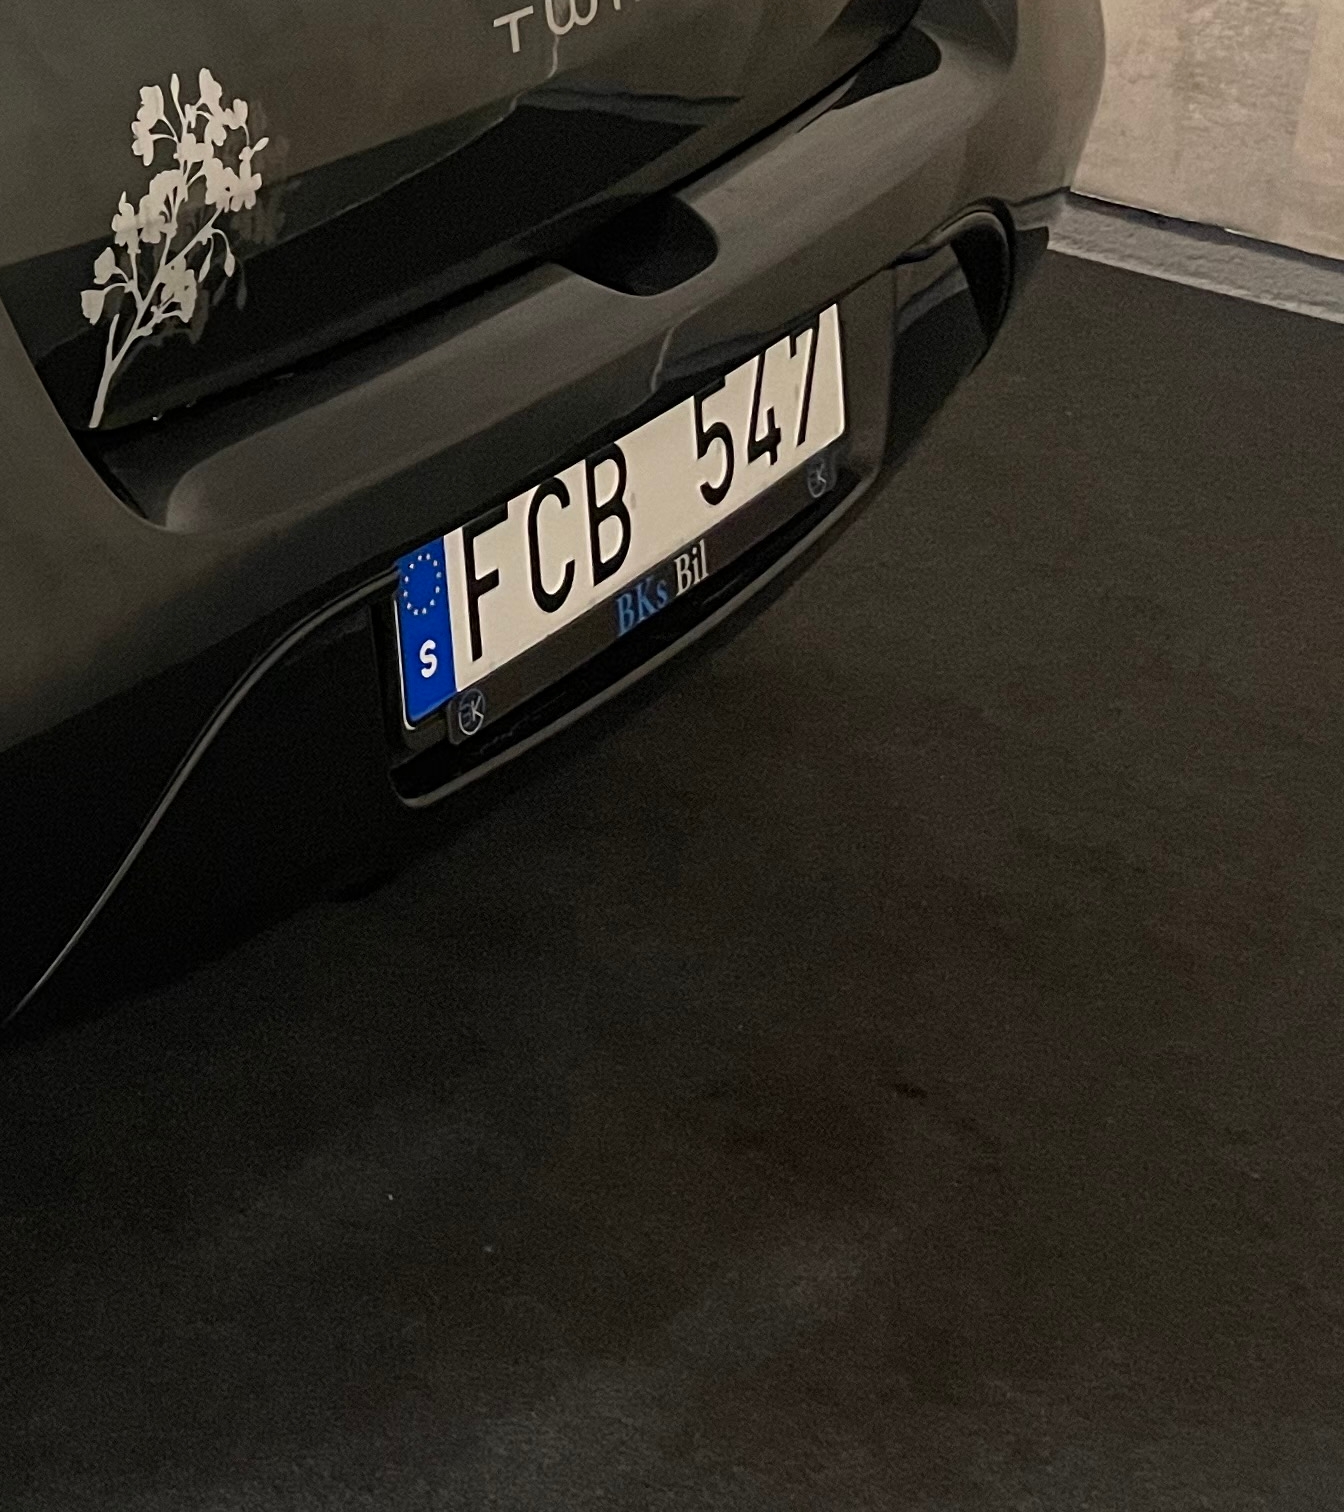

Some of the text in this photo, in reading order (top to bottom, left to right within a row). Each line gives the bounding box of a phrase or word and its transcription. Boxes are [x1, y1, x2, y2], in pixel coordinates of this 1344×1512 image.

[461, 314, 822, 662] FCB 547
[614, 539, 709, 637] BKs Bil
[419, 639, 438, 679] S
